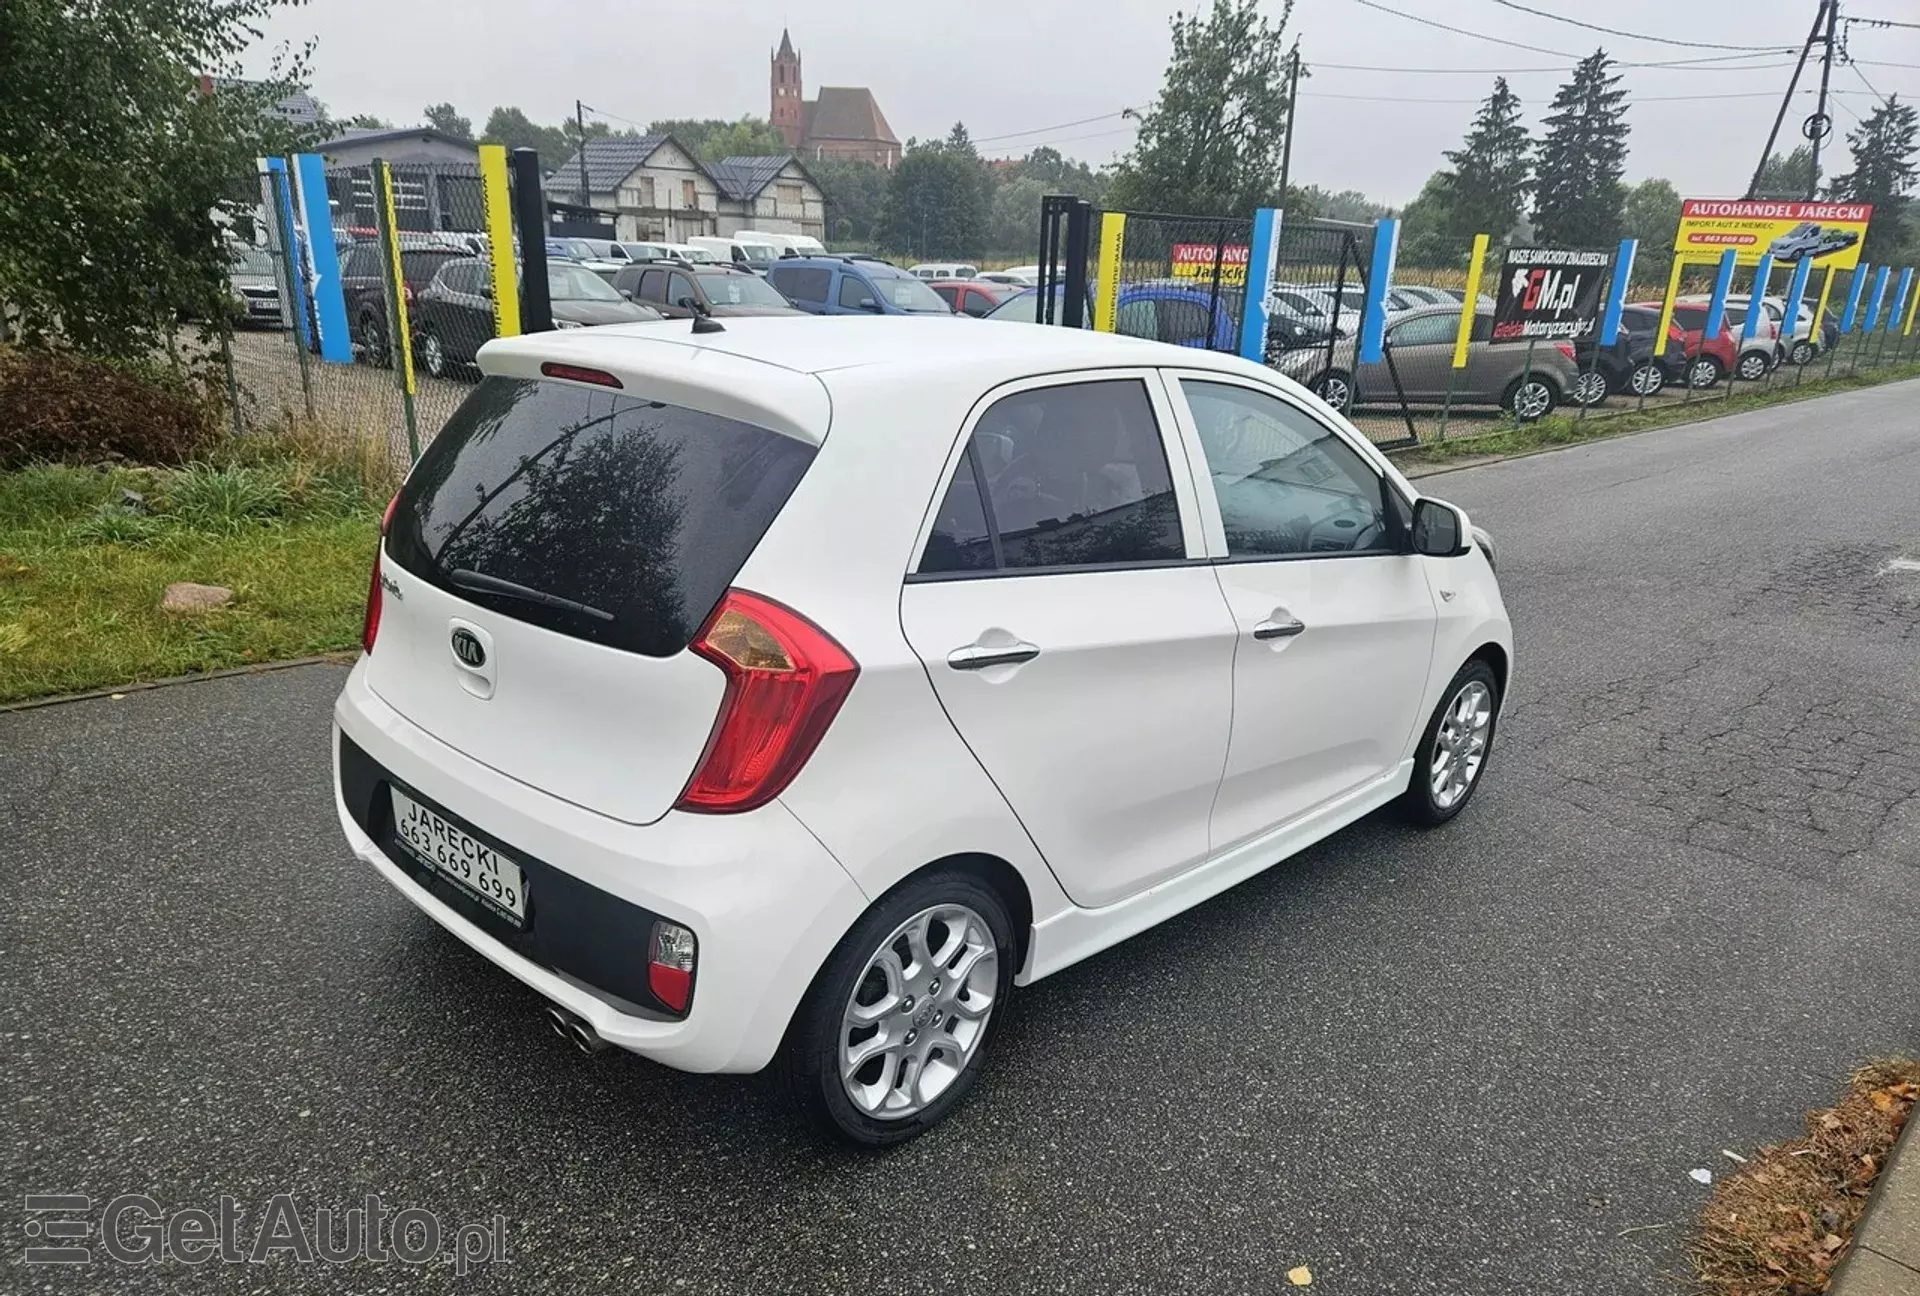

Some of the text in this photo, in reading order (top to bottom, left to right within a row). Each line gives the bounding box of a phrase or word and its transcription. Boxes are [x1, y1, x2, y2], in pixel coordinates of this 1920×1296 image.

[1686, 220, 1716, 228] IMPORT
[1717, 221, 1734, 229] AUT
[1741, 222, 1774, 230] NIEMIEC
[1689, 203, 1866, 220] AUTOHANDEL JARECKI
[1522, 268, 1581, 320] GM.pl
[453, 633, 480, 663] KIA
[408, 803, 499, 876] JARECKI
[400, 818, 516, 908] 663 669 699
